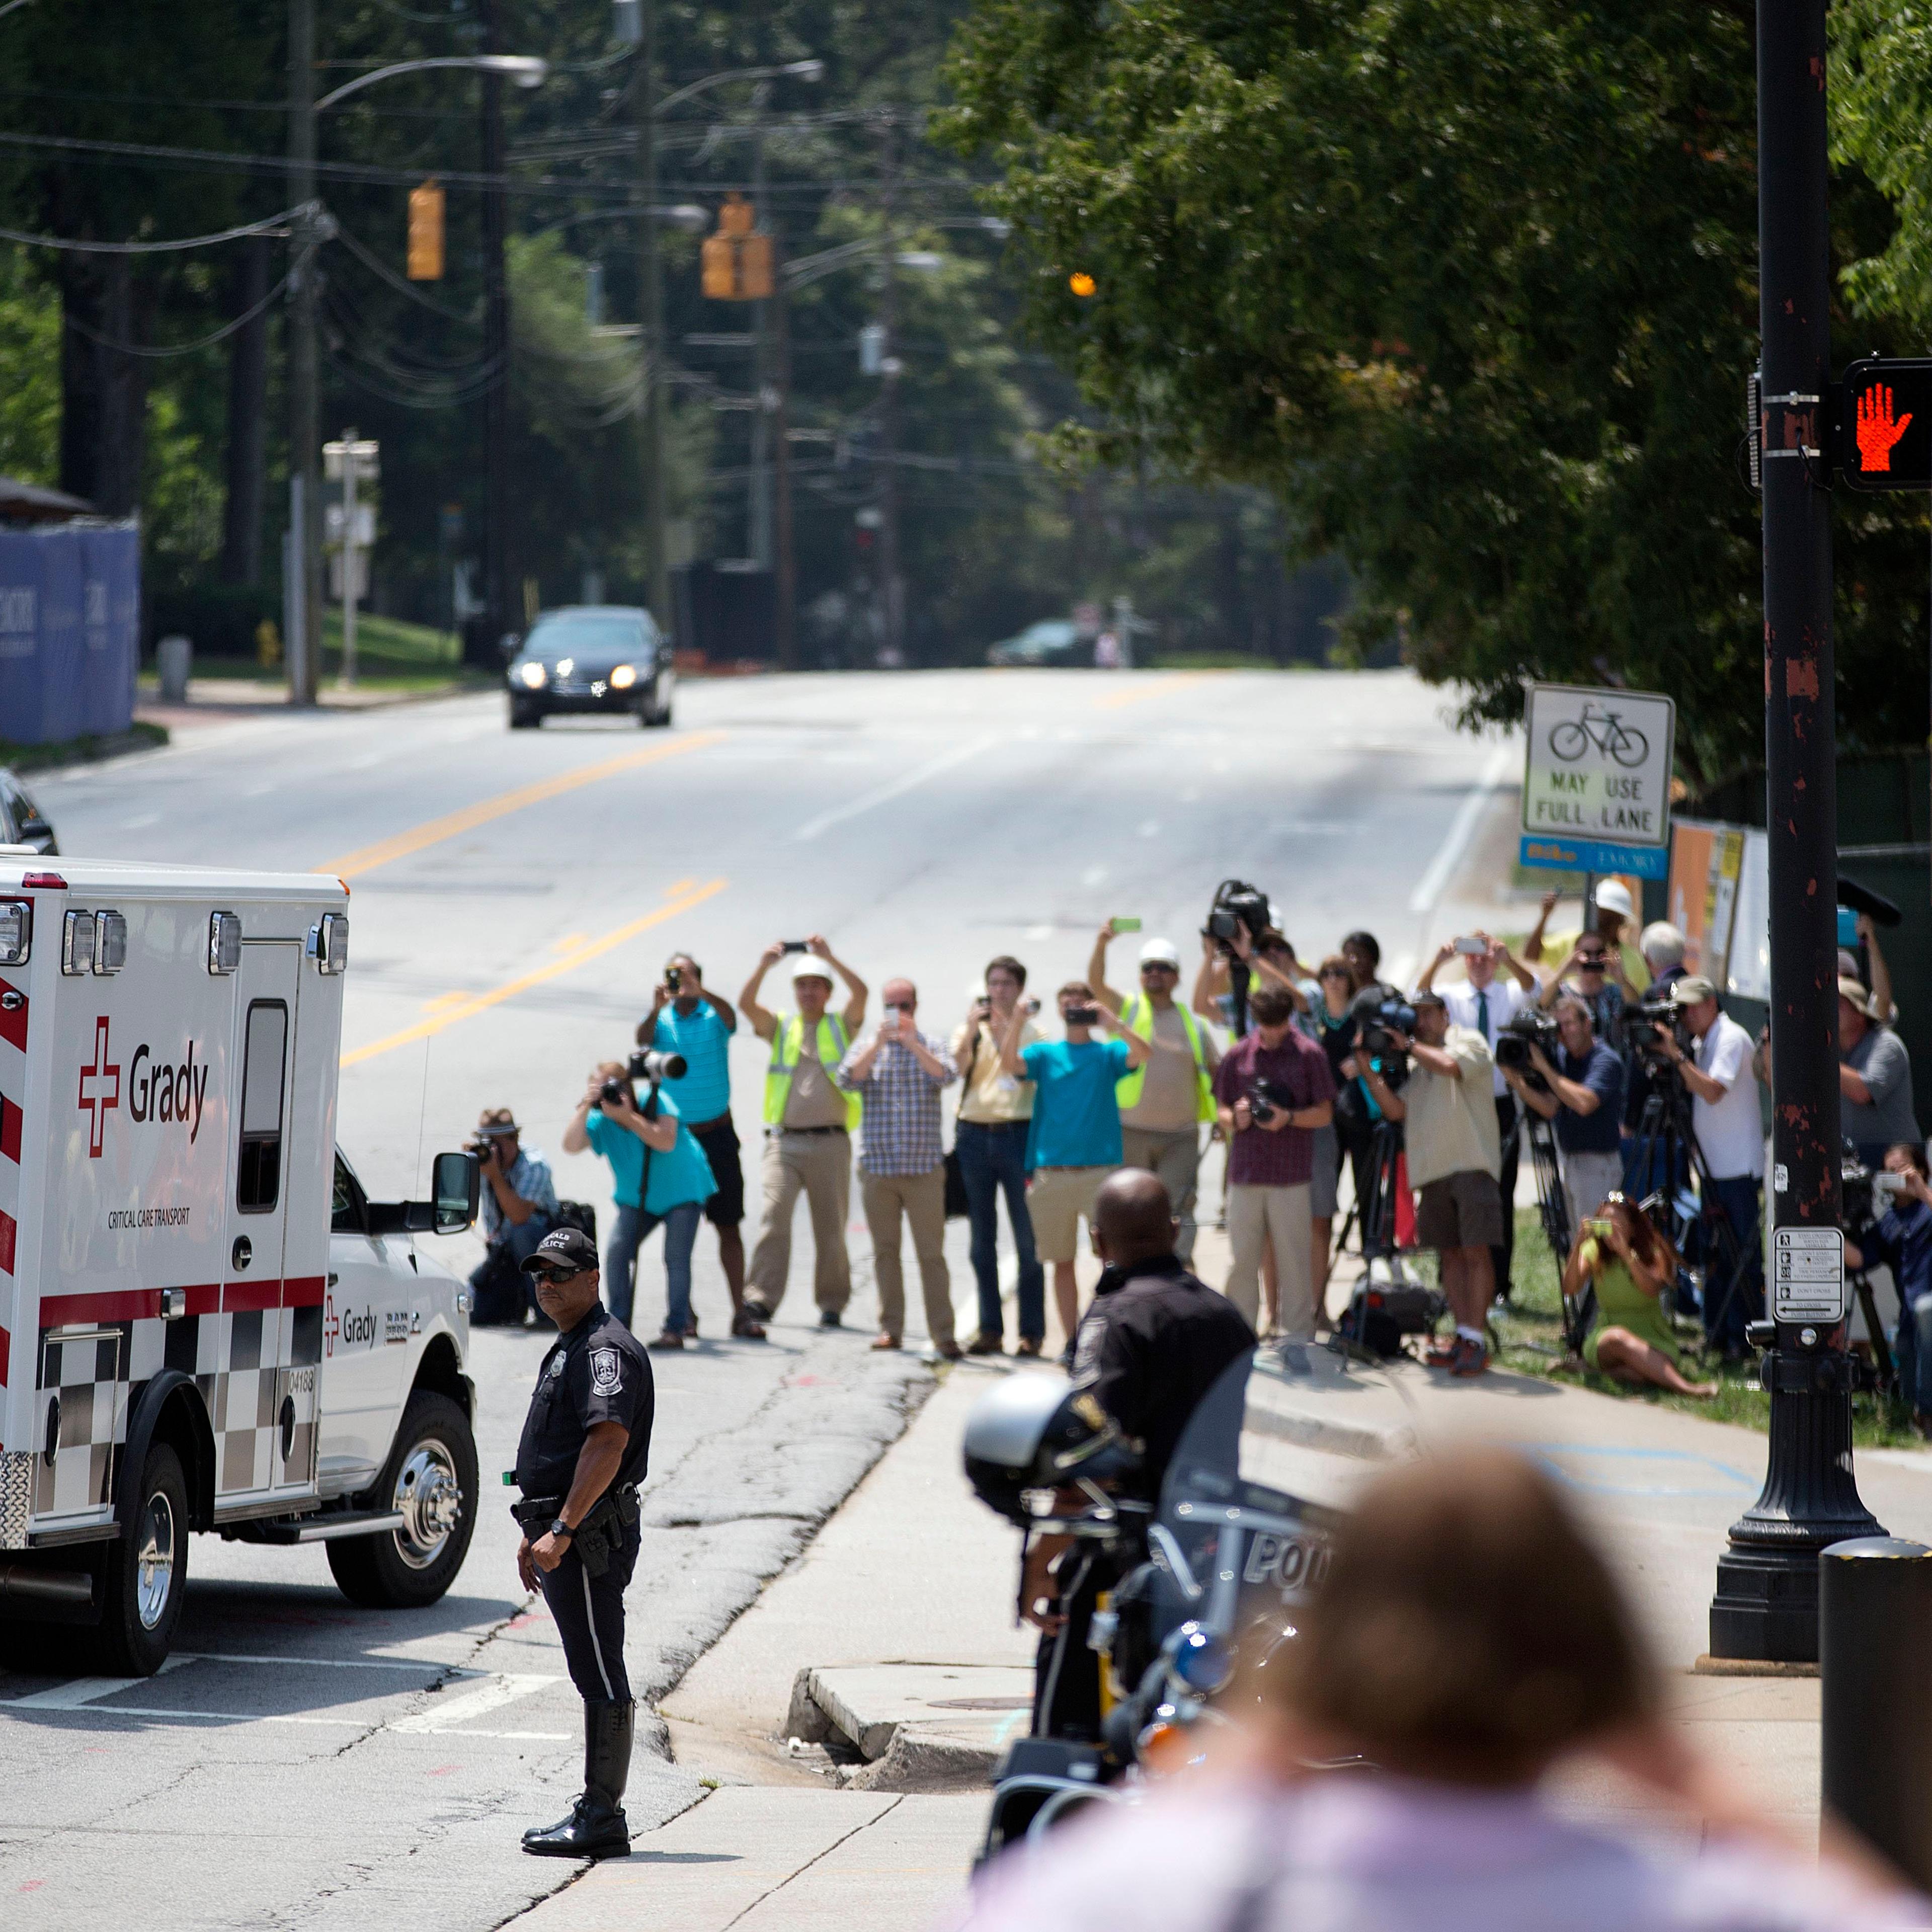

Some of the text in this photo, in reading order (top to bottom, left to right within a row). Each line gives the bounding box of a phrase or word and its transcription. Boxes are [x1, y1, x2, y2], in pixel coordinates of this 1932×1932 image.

[1551, 771, 1642, 800] MAY USE
[1536, 799, 1652, 831] FULL LANE
[129, 1040, 208, 1145] Grady
[108, 1208, 190, 1229] CRITICAL CARE TRANSPORT
[344, 1305, 376, 1350] Grady
[289, 1370, 313, 1393] 04188
